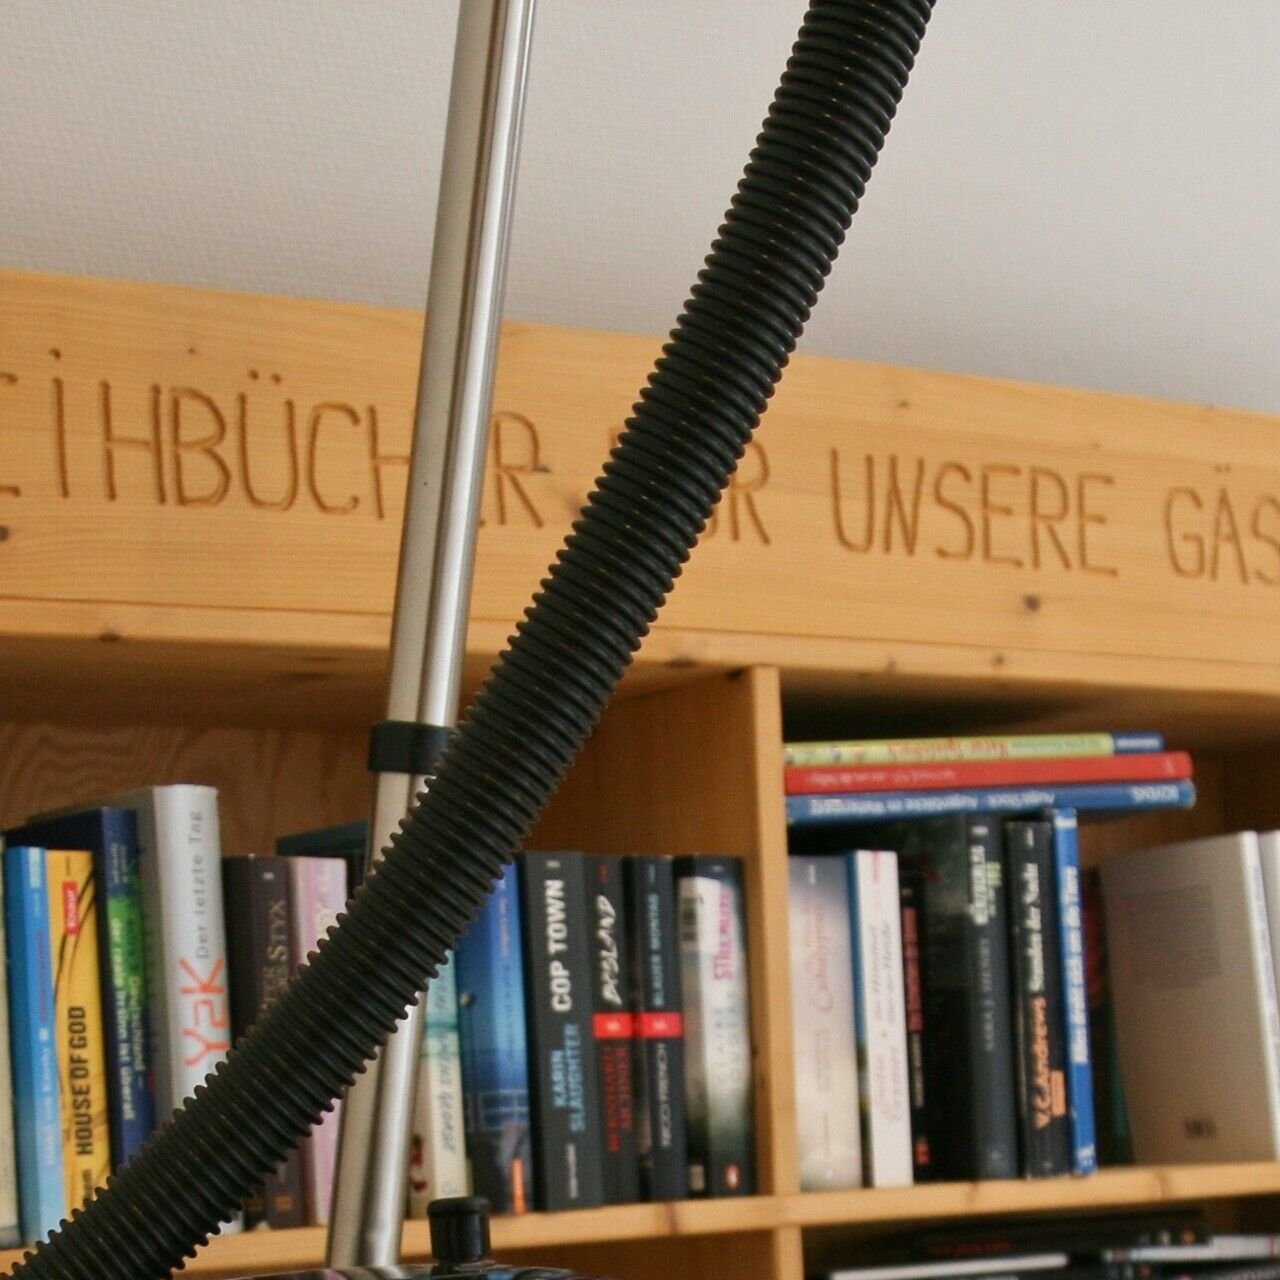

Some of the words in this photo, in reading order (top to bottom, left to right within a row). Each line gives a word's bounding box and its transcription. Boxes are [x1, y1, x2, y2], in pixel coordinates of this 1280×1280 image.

[828, 446, 1120, 578] UNSERE
[188, 810, 206, 844] Tag
[189, 854, 209, 915] letzte
[110, 918, 125, 942] der
[545, 879, 568, 953] TOWN
[112, 948, 126, 986] reale
[193, 924, 211, 960] Der
[549, 961, 573, 1011] COP
[67, 1006, 88, 1049] GOD
[115, 991, 129, 1038] Irrsinn
[128, 976, 145, 1071] Deutschland
[179, 957, 229, 1067] Y2K
[69, 1053, 89, 1083] OF
[118, 1043, 131, 1062] ist
[564, 1024, 586, 1131] SLAUGHTER
[120, 1068, 135, 1120] überall
[551, 1050, 567, 1108] KARIN
[70, 1087, 93, 1156] HOUSE
